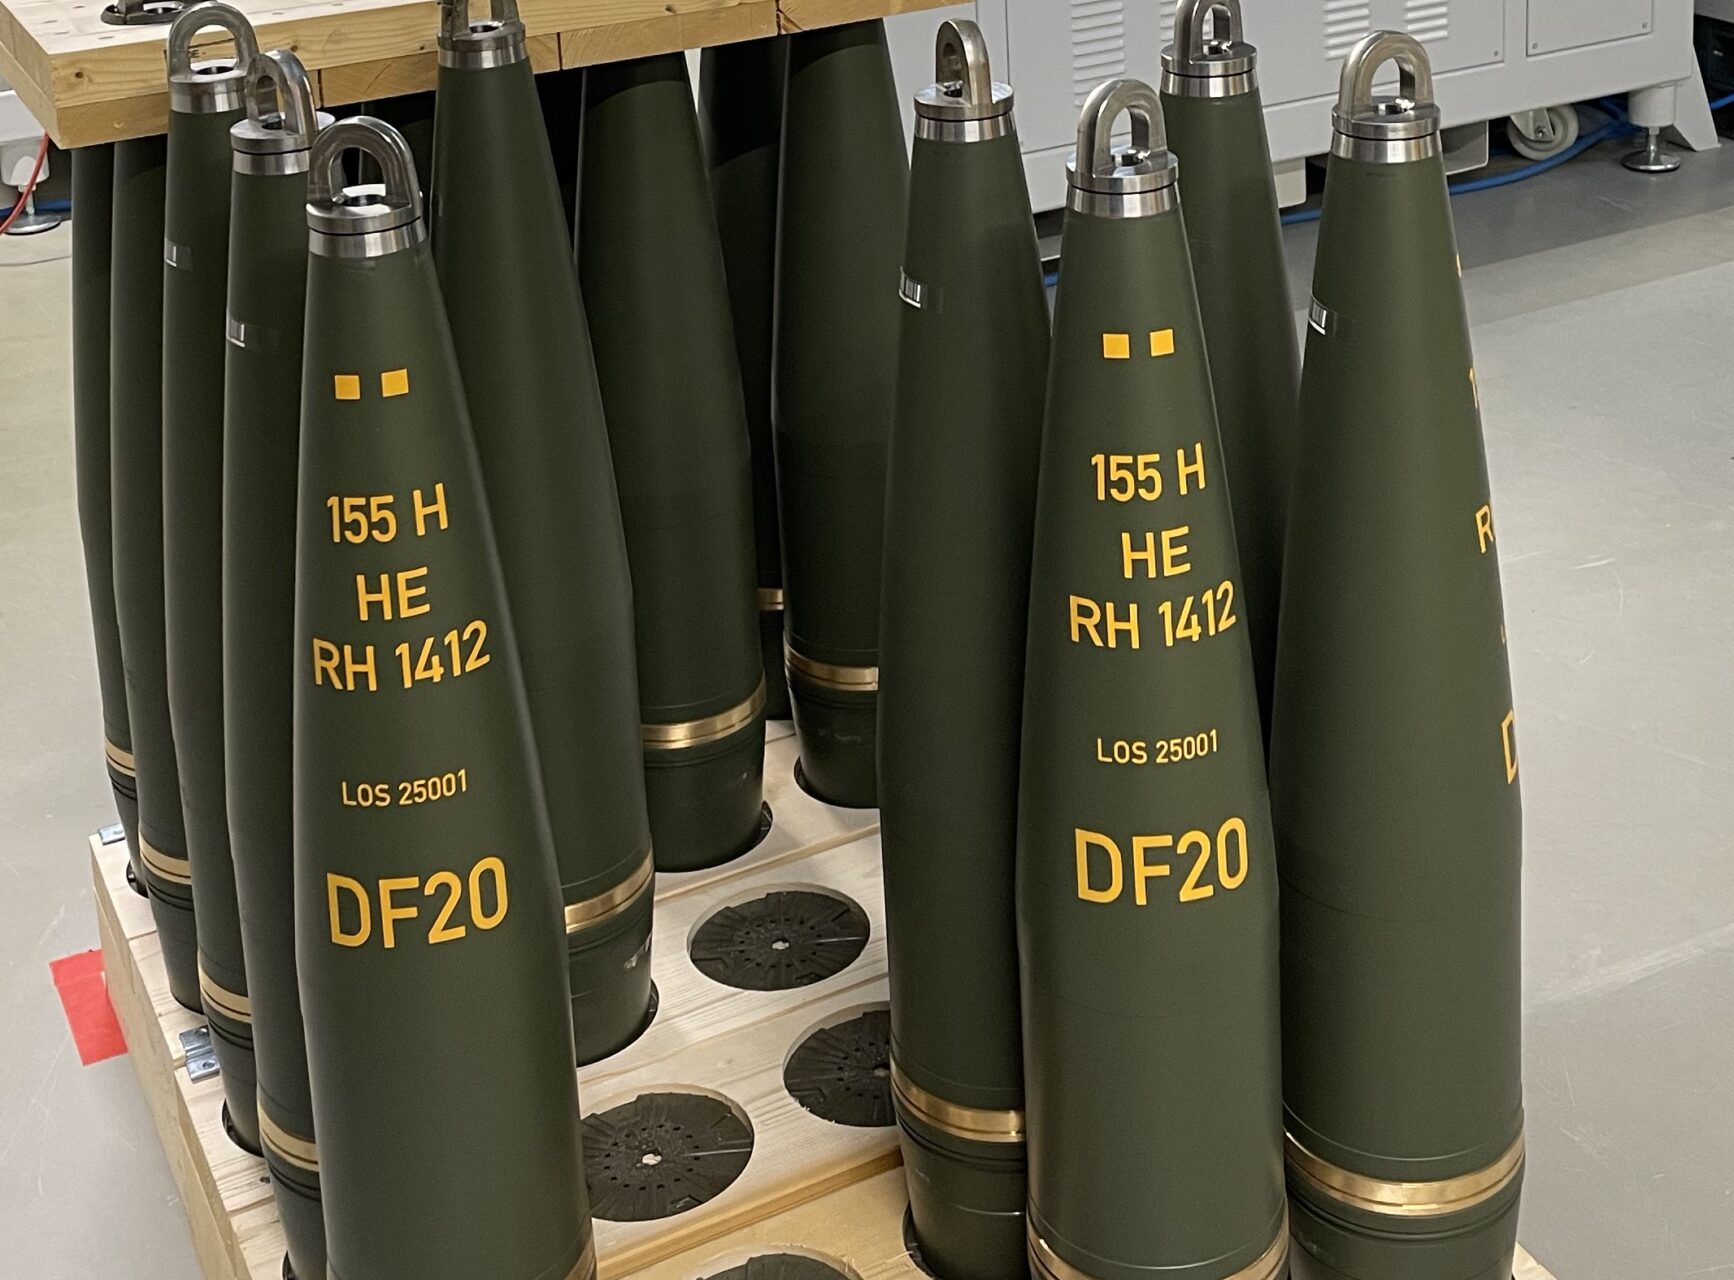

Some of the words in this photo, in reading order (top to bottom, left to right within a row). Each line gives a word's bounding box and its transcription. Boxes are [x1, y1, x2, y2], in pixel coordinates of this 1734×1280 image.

[1091, 453, 1163, 503] 155
[1176, 442, 1206, 495] H
[326, 495, 397, 544] 155
[413, 482, 449, 537] H
[1475, 503, 1495, 554] R
[1121, 525, 1190, 579] HE
[356, 566, 431, 621] HE
[1069, 594, 1140, 650] RH
[1158, 580, 1237, 648] 1412
[312, 638, 378, 692] RH
[395, 620, 491, 690] 1412
[1097, 738, 1148, 765] LOS
[1156, 728, 1218, 764] 25001
[342, 781, 391, 806] LOS
[399, 768, 467, 806] 25001
[1075, 816, 1249, 907] DF20
[326, 856, 509, 949] DF20
